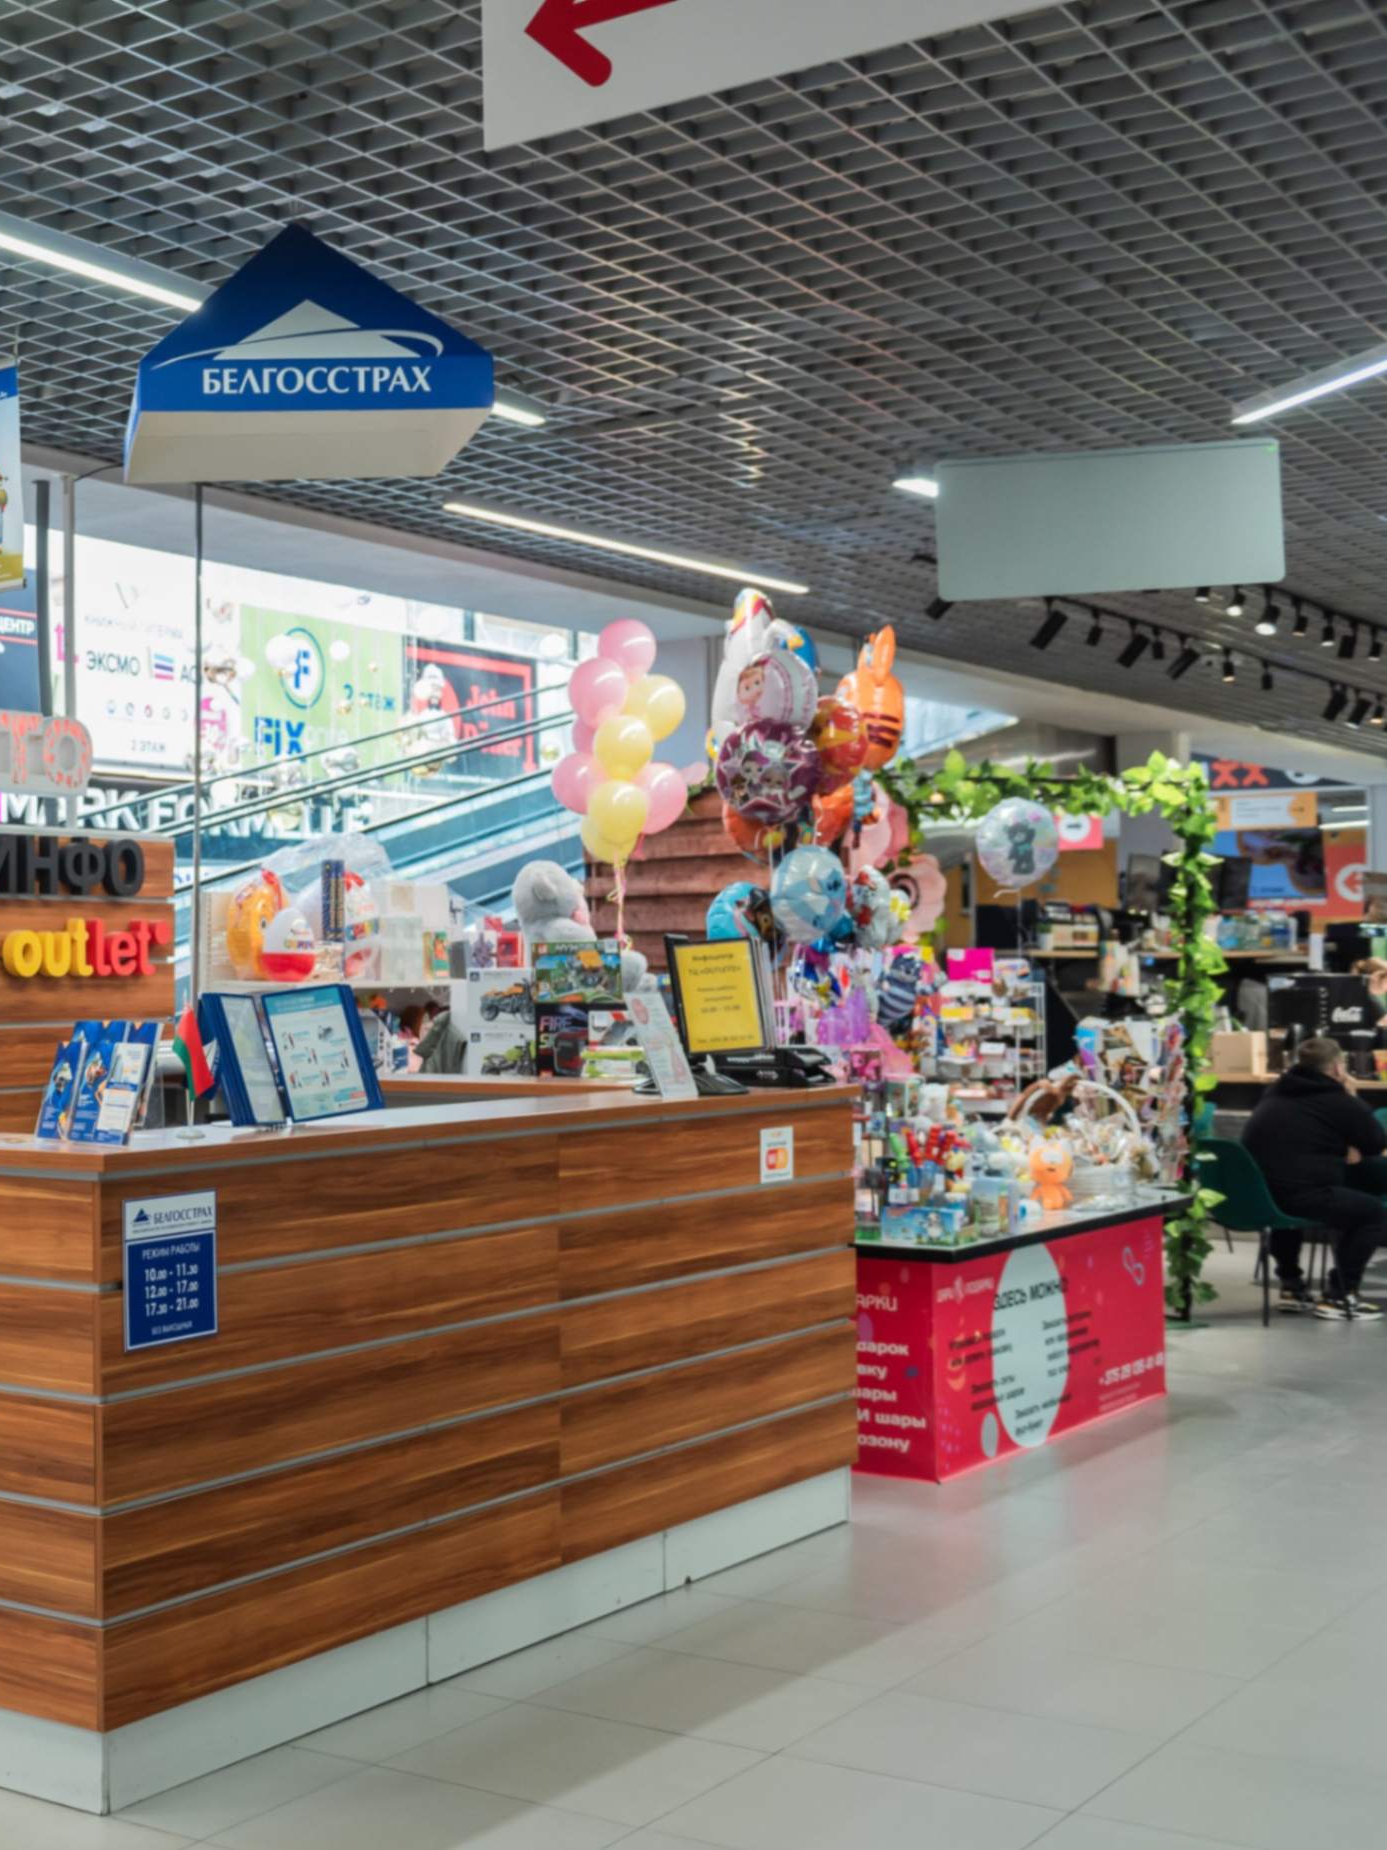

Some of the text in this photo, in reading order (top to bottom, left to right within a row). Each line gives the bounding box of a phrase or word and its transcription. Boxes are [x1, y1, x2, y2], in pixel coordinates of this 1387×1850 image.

[202, 366, 432, 395] БЕЛГОССТРАХ
[86, 650, 141, 676] ЭКСМО
[2, 917, 159, 978] outlet
[154, 1207, 212, 1224] БЕЛГОССТРАХ
[993, 1275, 1068, 1311] ЗДЕСЬ МОЖНО
[856, 1294, 898, 1312] АРКИ
[856, 1341, 909, 1356] дарок
[857, 1364, 887, 1380] вку
[874, 1411, 927, 1429] шары
